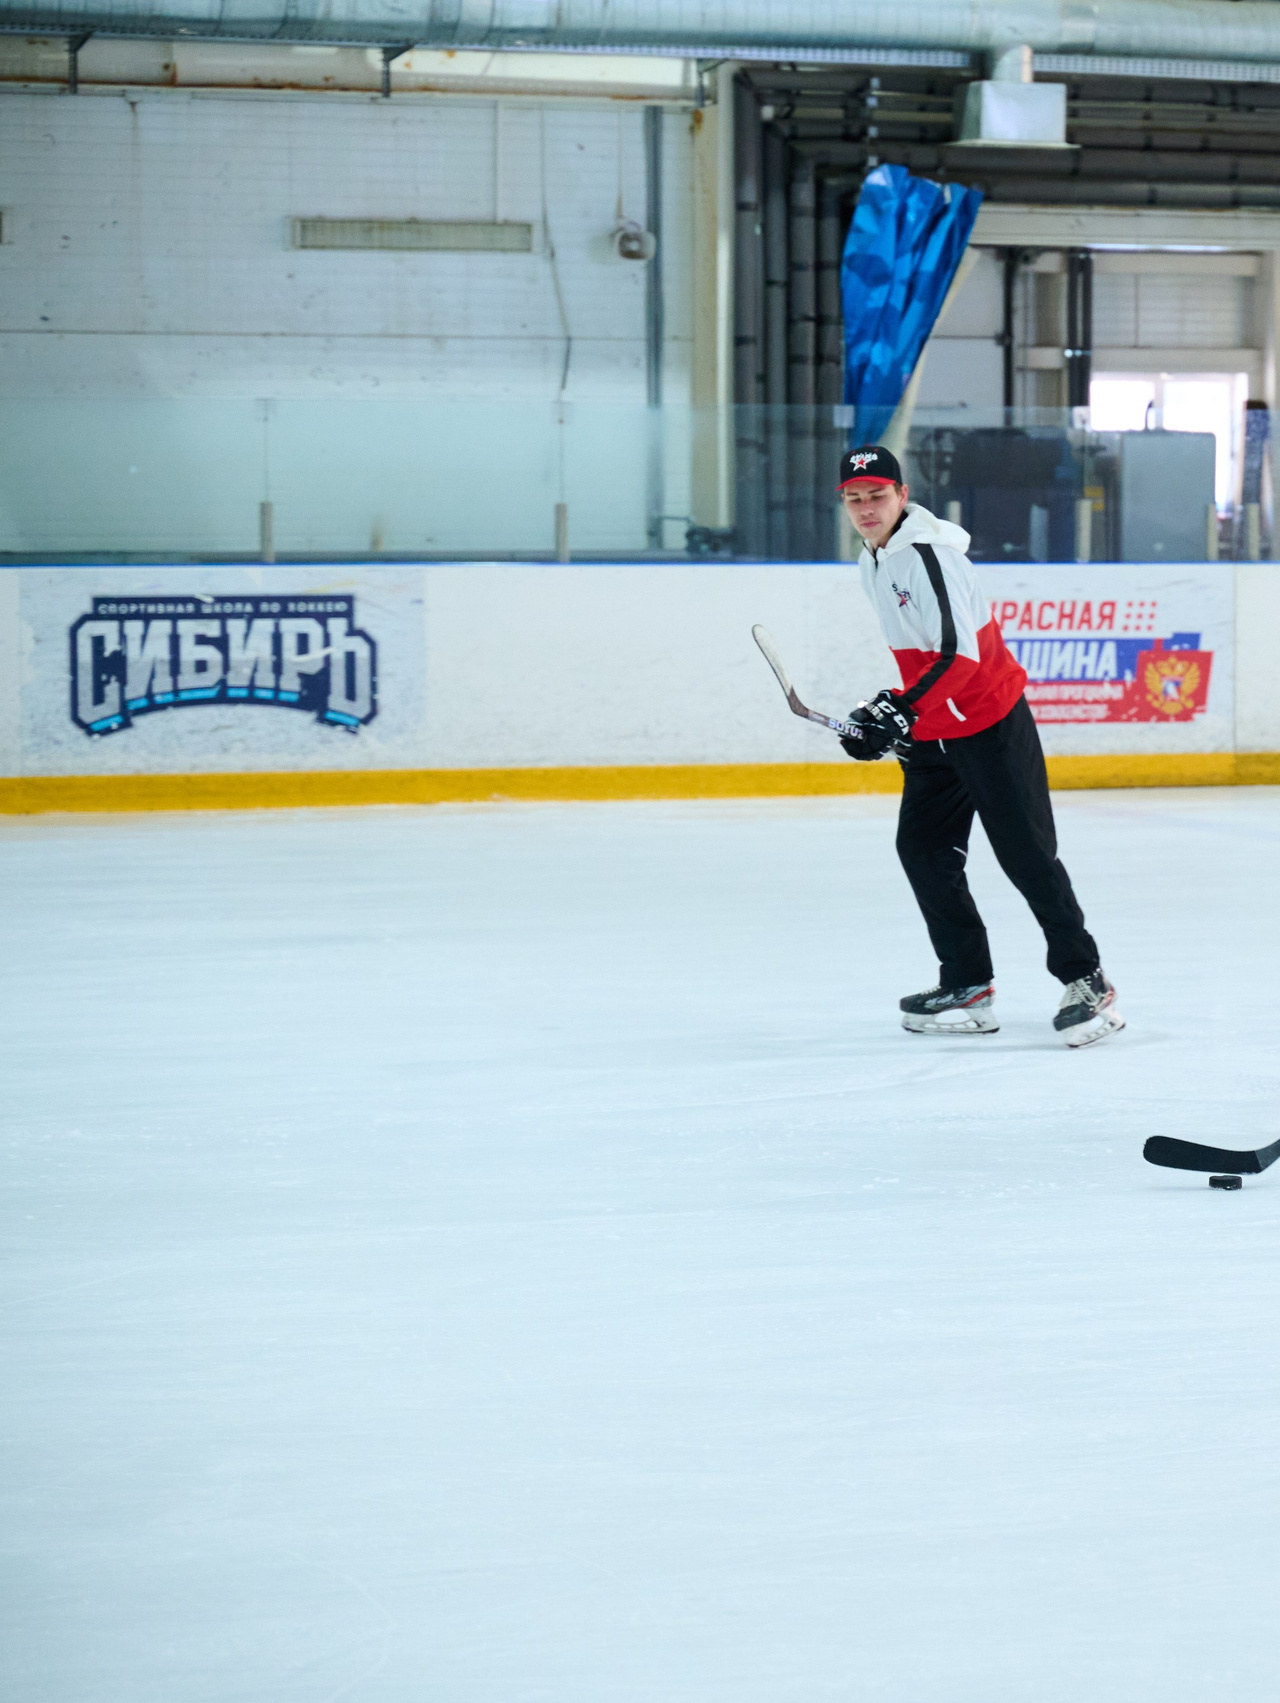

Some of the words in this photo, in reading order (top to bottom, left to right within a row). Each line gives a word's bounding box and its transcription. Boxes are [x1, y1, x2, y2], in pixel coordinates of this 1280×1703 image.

[98, 602, 196, 614] СПОРТИВНАЯ
[201, 602, 253, 614] ШКОЛА
[260, 601, 281, 613] ПО
[287, 601, 348, 613] ХОККЕЮ
[74, 616, 374, 732] СИБИРЬ
